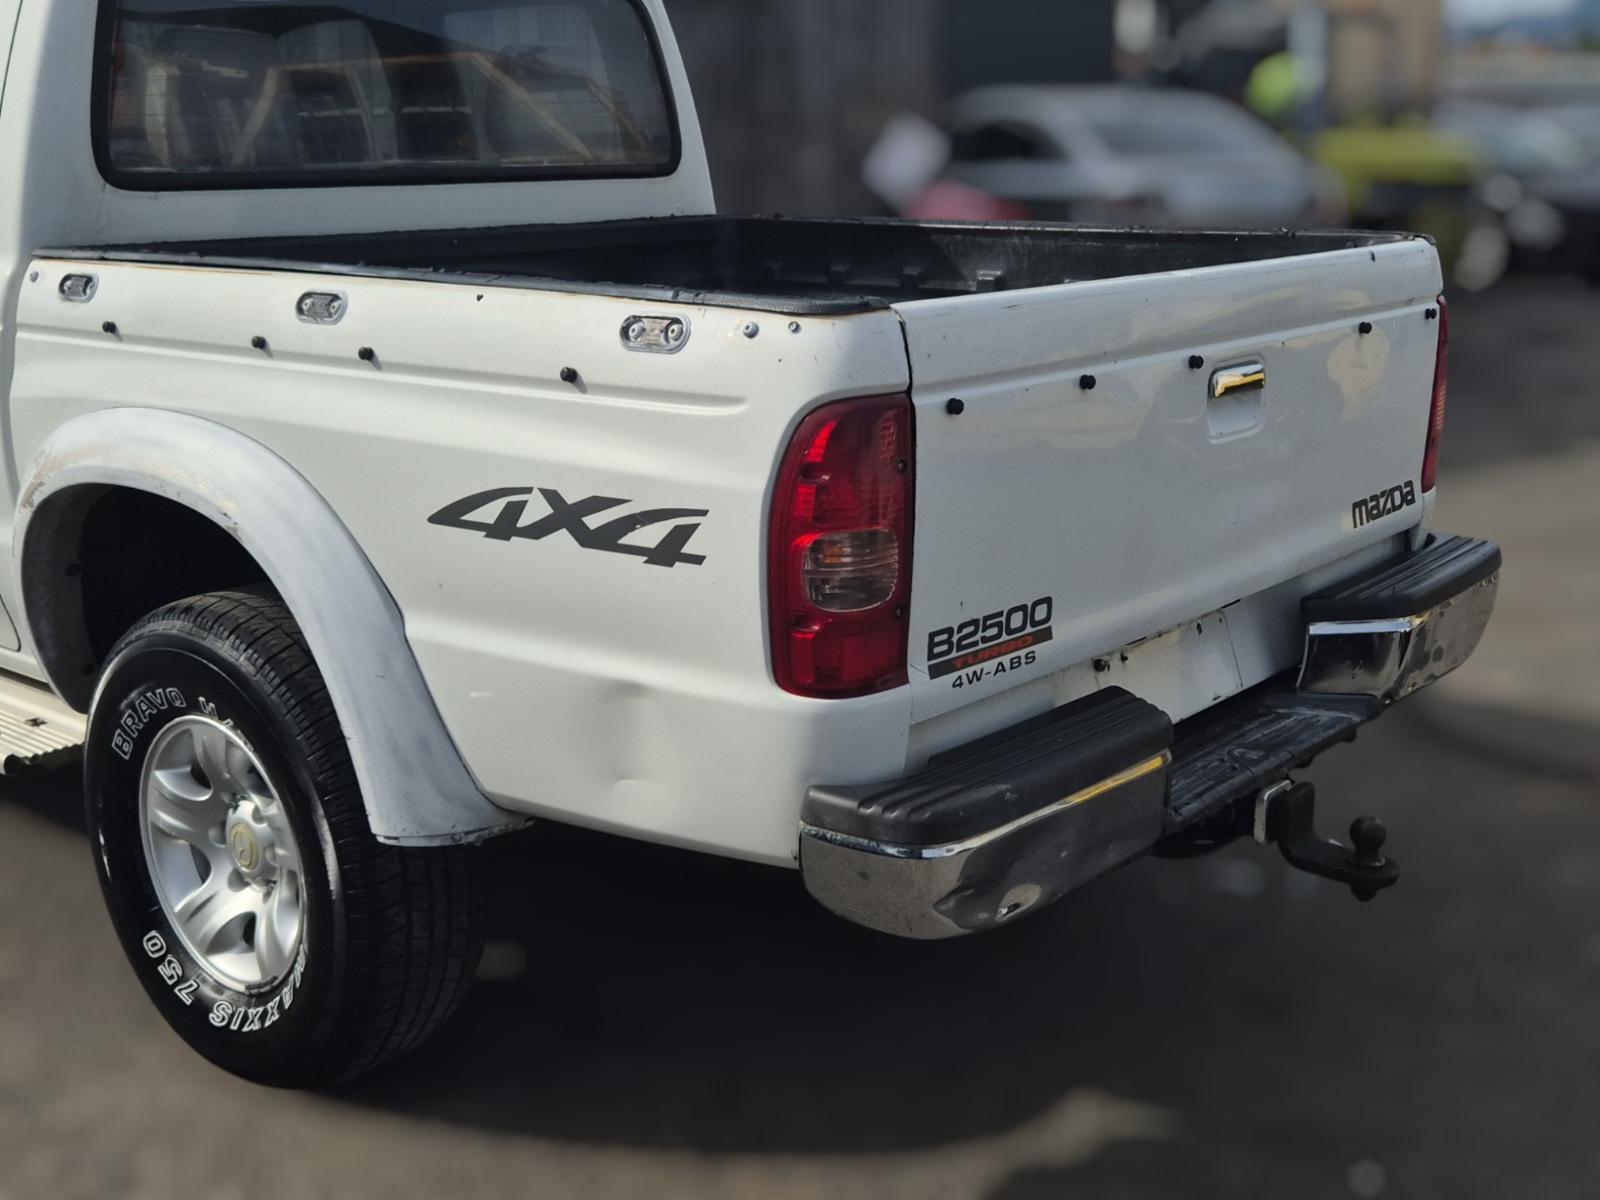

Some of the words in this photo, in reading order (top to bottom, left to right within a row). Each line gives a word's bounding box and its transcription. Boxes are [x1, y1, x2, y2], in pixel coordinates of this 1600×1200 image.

[927, 596, 1053, 662] B2500
[953, 634, 1034, 669] TURBO
[952, 651, 1036, 688] 4W-ABS
[112, 686, 186, 760] BRAVO
[143, 930, 199, 1005] 750
[209, 944, 306, 1032] MAXXIS
